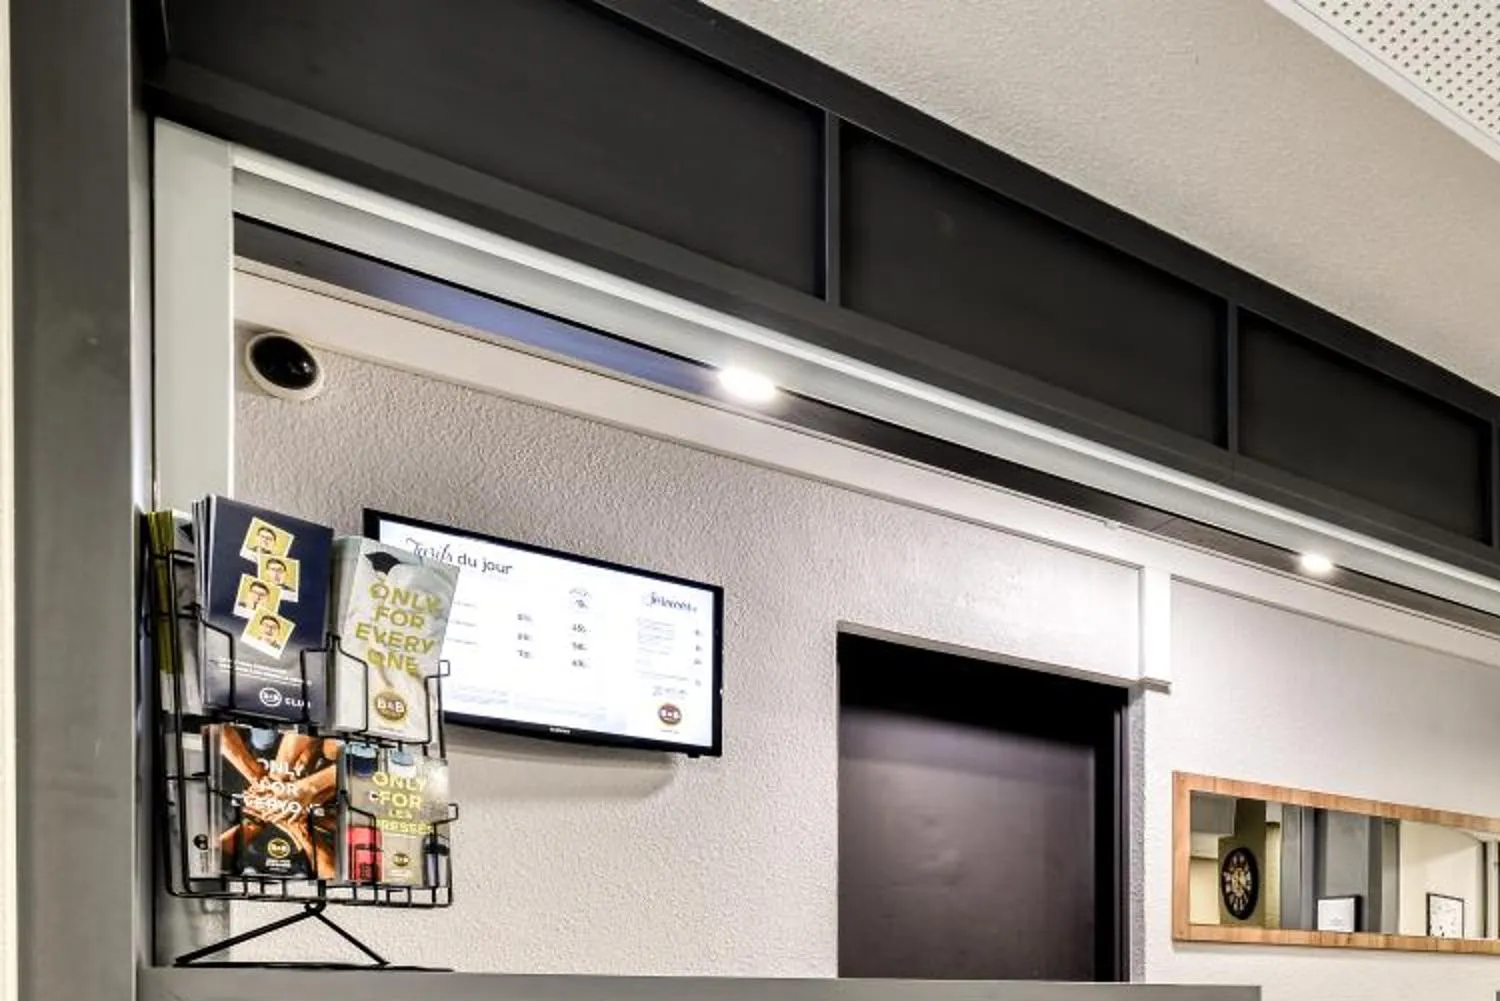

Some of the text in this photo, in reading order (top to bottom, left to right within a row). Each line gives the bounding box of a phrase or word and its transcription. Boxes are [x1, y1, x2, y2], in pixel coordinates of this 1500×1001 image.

[458, 553, 477, 568] du
[481, 557, 513, 575] jour
[369, 581, 443, 615] ONLY
[374, 605, 425, 630] FOR
[355, 621, 435, 654] EVERY
[367, 648, 418, 675] ONE
[372, 771, 426, 793] ONLY
